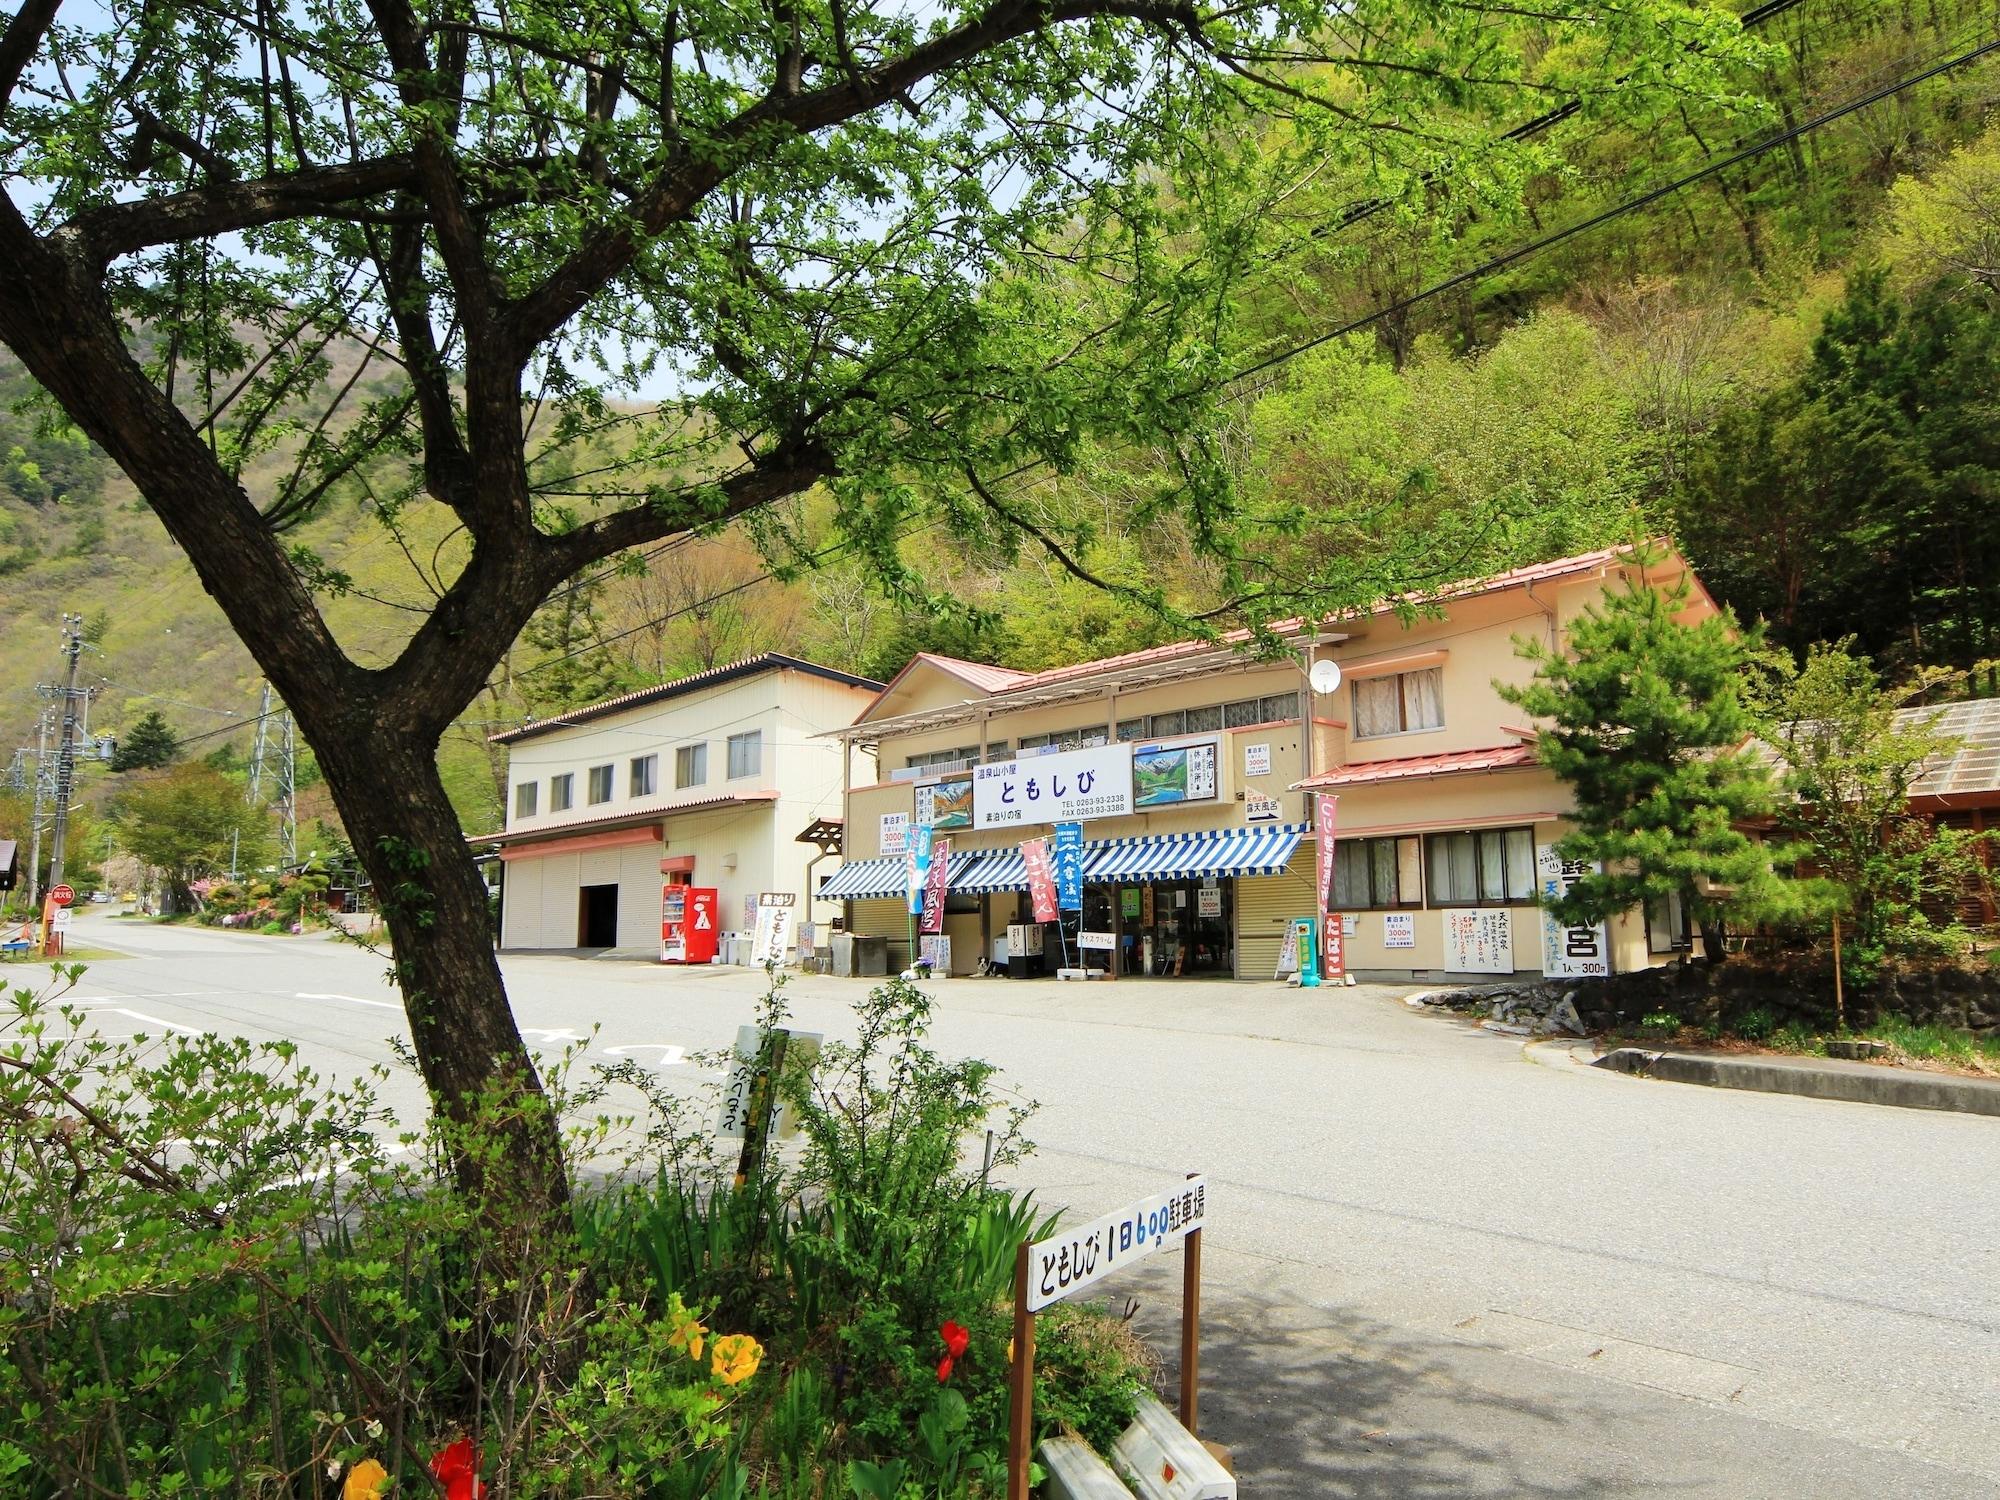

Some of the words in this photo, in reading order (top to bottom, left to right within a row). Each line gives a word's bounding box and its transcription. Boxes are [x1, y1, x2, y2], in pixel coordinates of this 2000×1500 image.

[977, 764, 1017, 780] 温泉山小屋
[1001, 769, 1096, 804] ともしび
[1076, 794, 1125, 807] 0263-93-2338
[1247, 801, 1278, 813] 露天風呂
[986, 809, 1022, 823] 素泊りの宿
[1062, 809, 1075, 817] FAX
[1076, 803, 1125, 816] 0263-93-3388
[921, 846, 945, 929] 露天風呂
[762, 894, 794, 906] 素泊り
[769, 909, 787, 959] ともしび
[1326, 917, 1341, 974] たばこ
